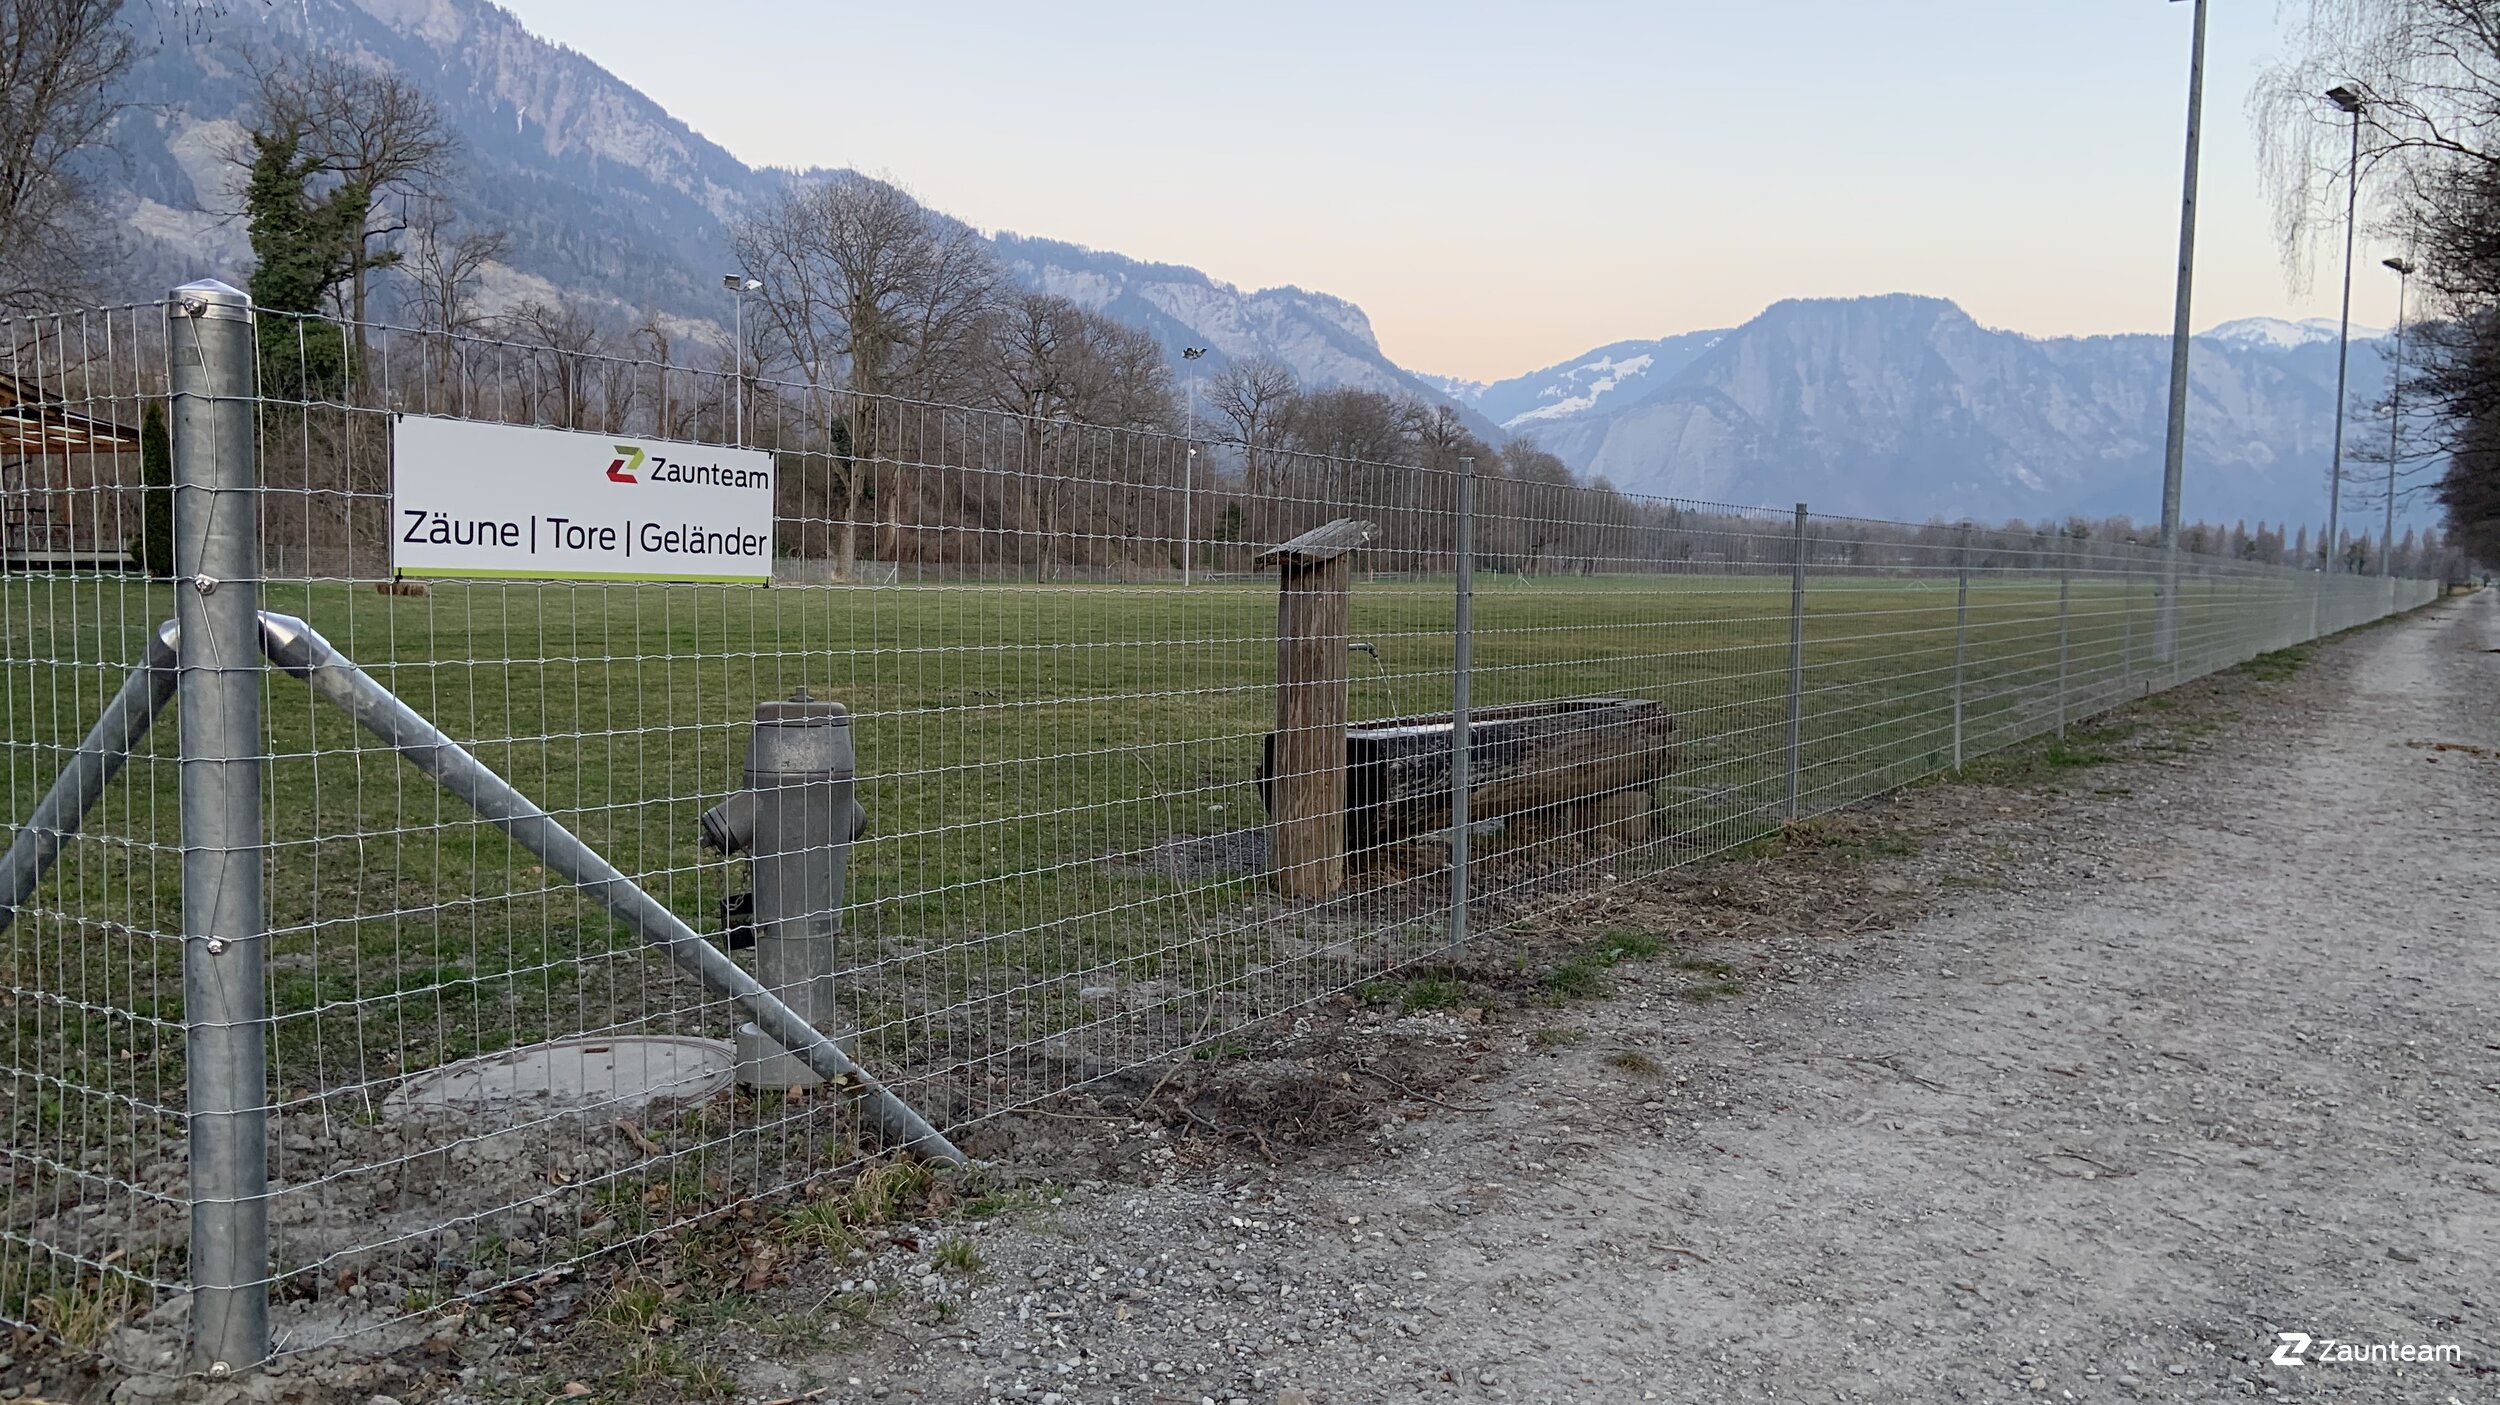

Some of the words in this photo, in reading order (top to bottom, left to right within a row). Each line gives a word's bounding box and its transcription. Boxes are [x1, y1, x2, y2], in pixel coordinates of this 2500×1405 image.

[650, 457, 769, 490] Zaunteam
[403, 509, 520, 547] Zäune
[546, 517, 616, 551] Tore
[640, 522, 768, 557] Geländer
